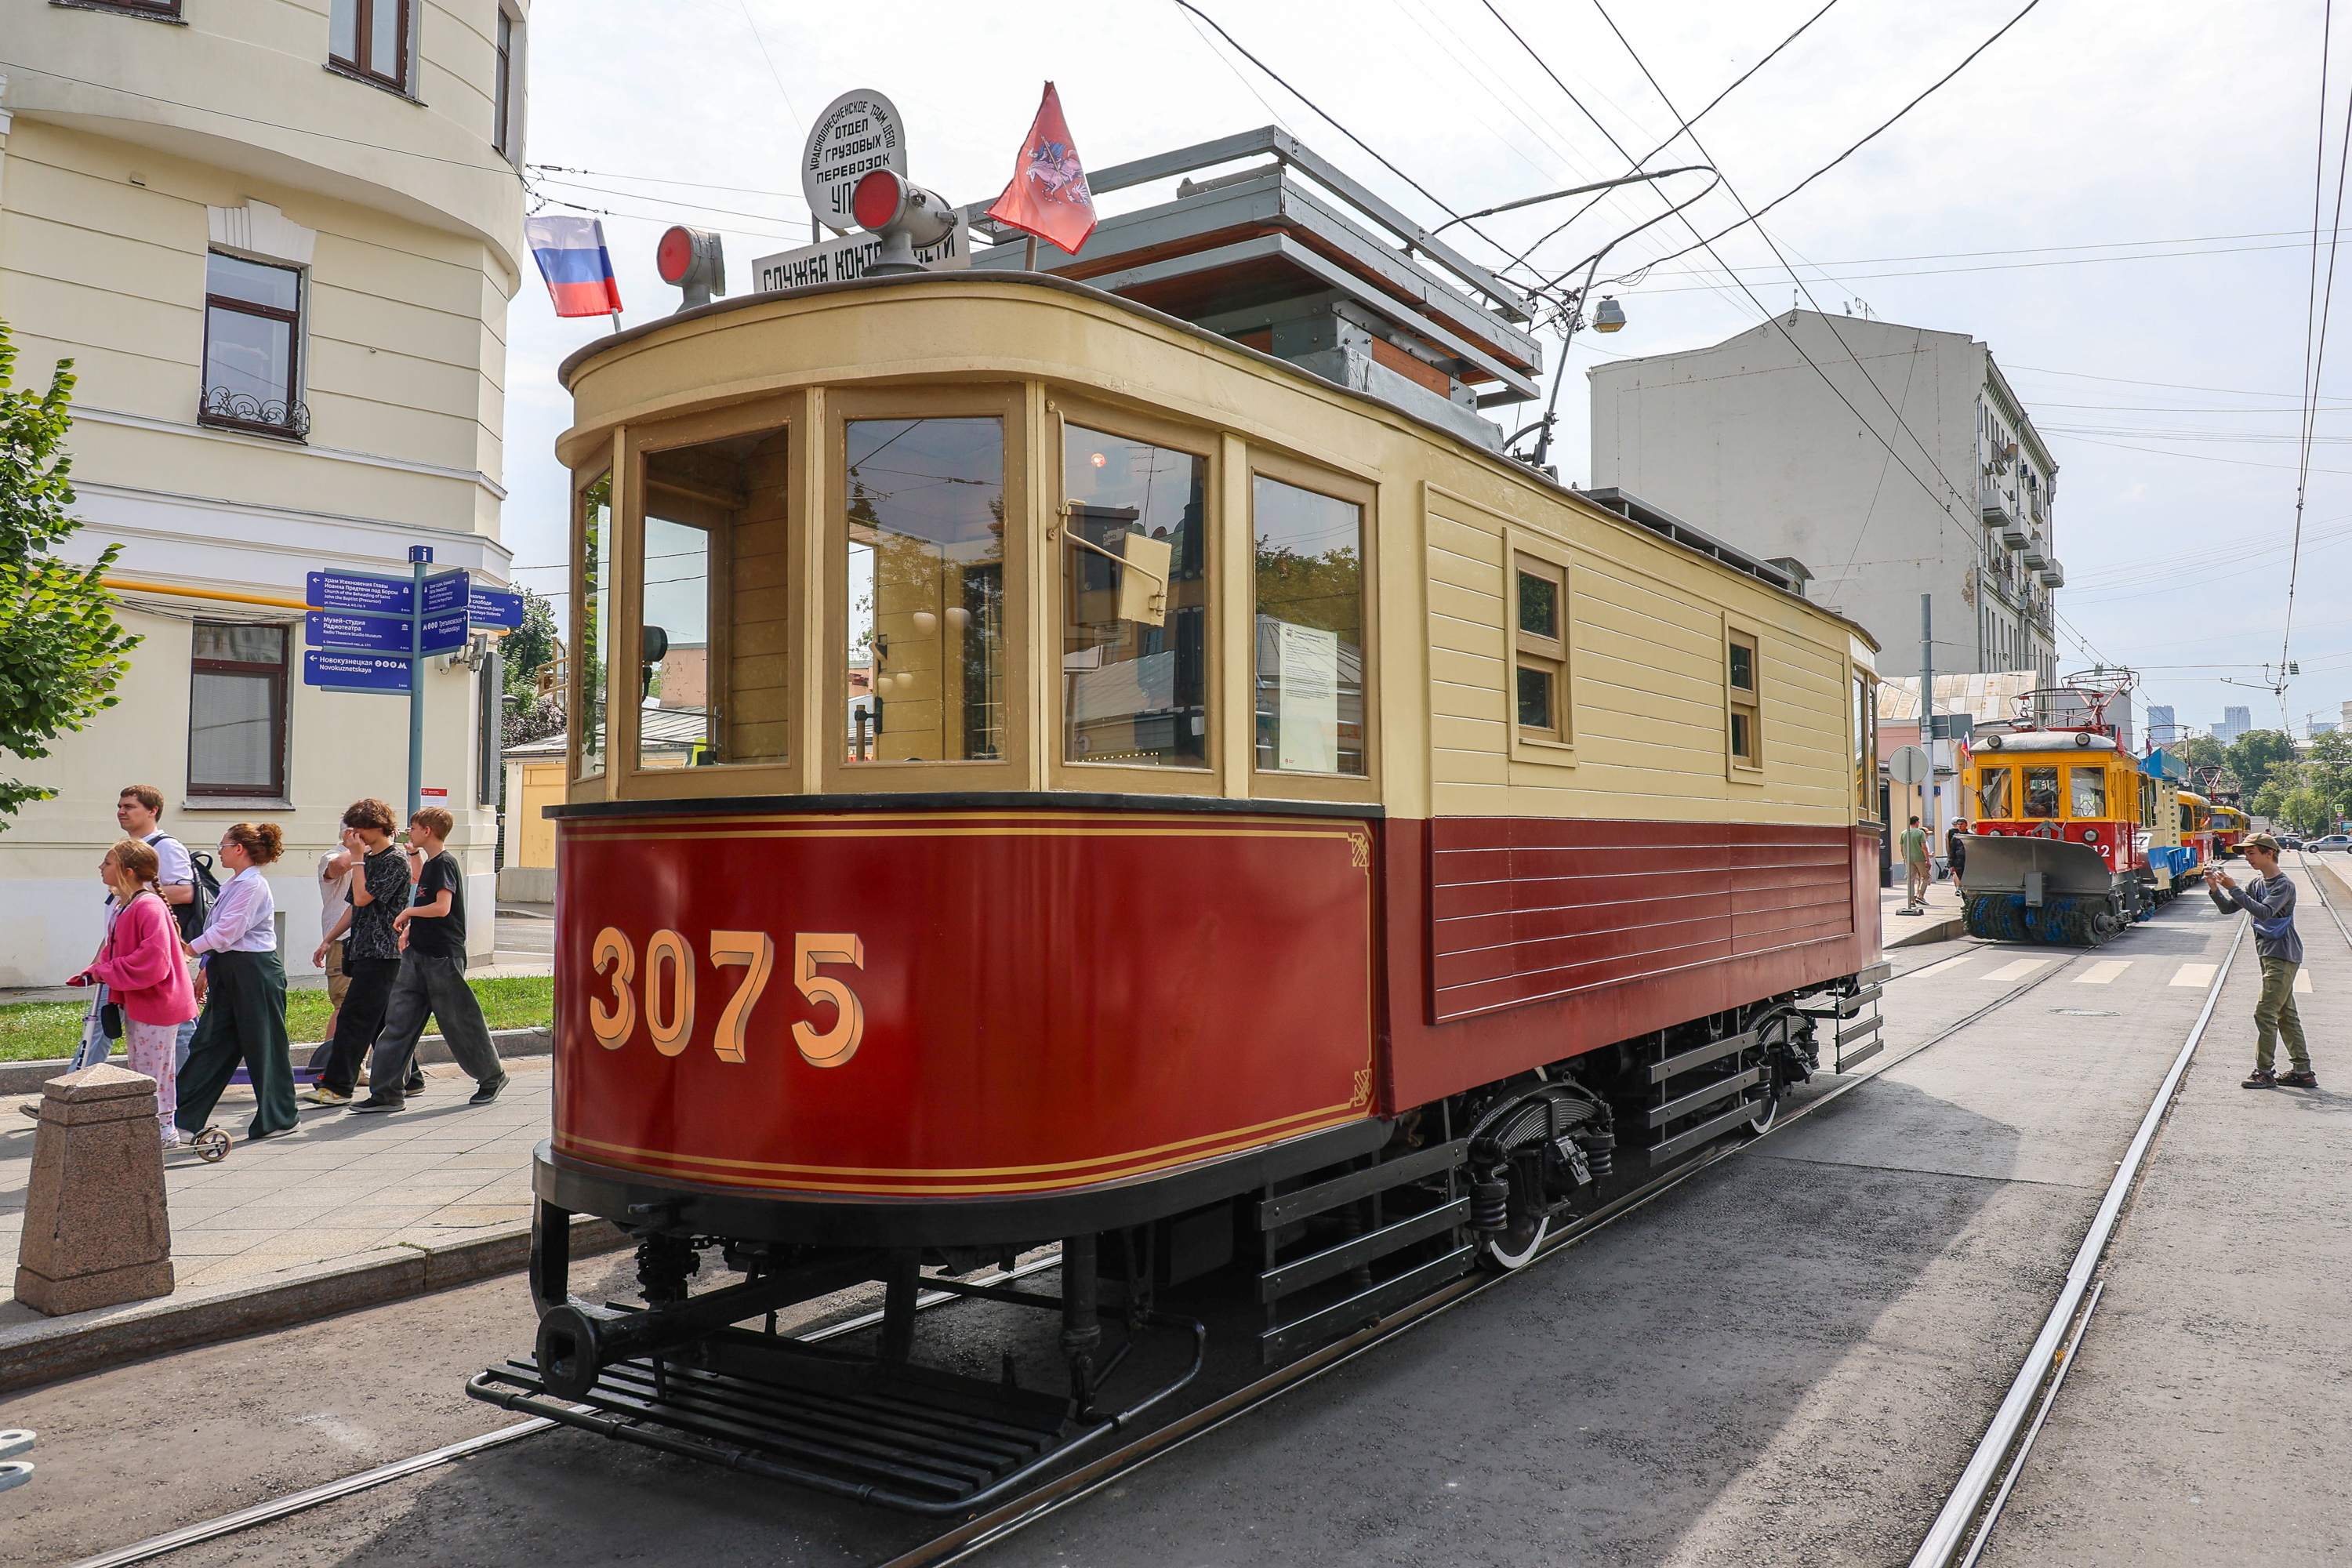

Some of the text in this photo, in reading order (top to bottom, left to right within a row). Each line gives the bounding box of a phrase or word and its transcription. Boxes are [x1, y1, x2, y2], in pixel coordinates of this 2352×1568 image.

[810, 100, 895, 171] КРАСНОПРЕСНЕНСКОЕ ТРАМ. ДЕПО
[835, 118, 869, 140] ОТДЕЛ
[826, 134, 881, 163] ГРУЗОВЫХ
[816, 153, 890, 184] ПЕРЕВОЗОК
[763, 254, 829, 292] СЛУЖБА
[339, 579, 372, 587] Усекновения
[323, 617, 366, 626] Музей-студия
[319, 656, 372, 666] Новокузнецкая
[319, 664, 372, 673] Novokuznetskaya
[590, 926, 865, 1069] 3075
